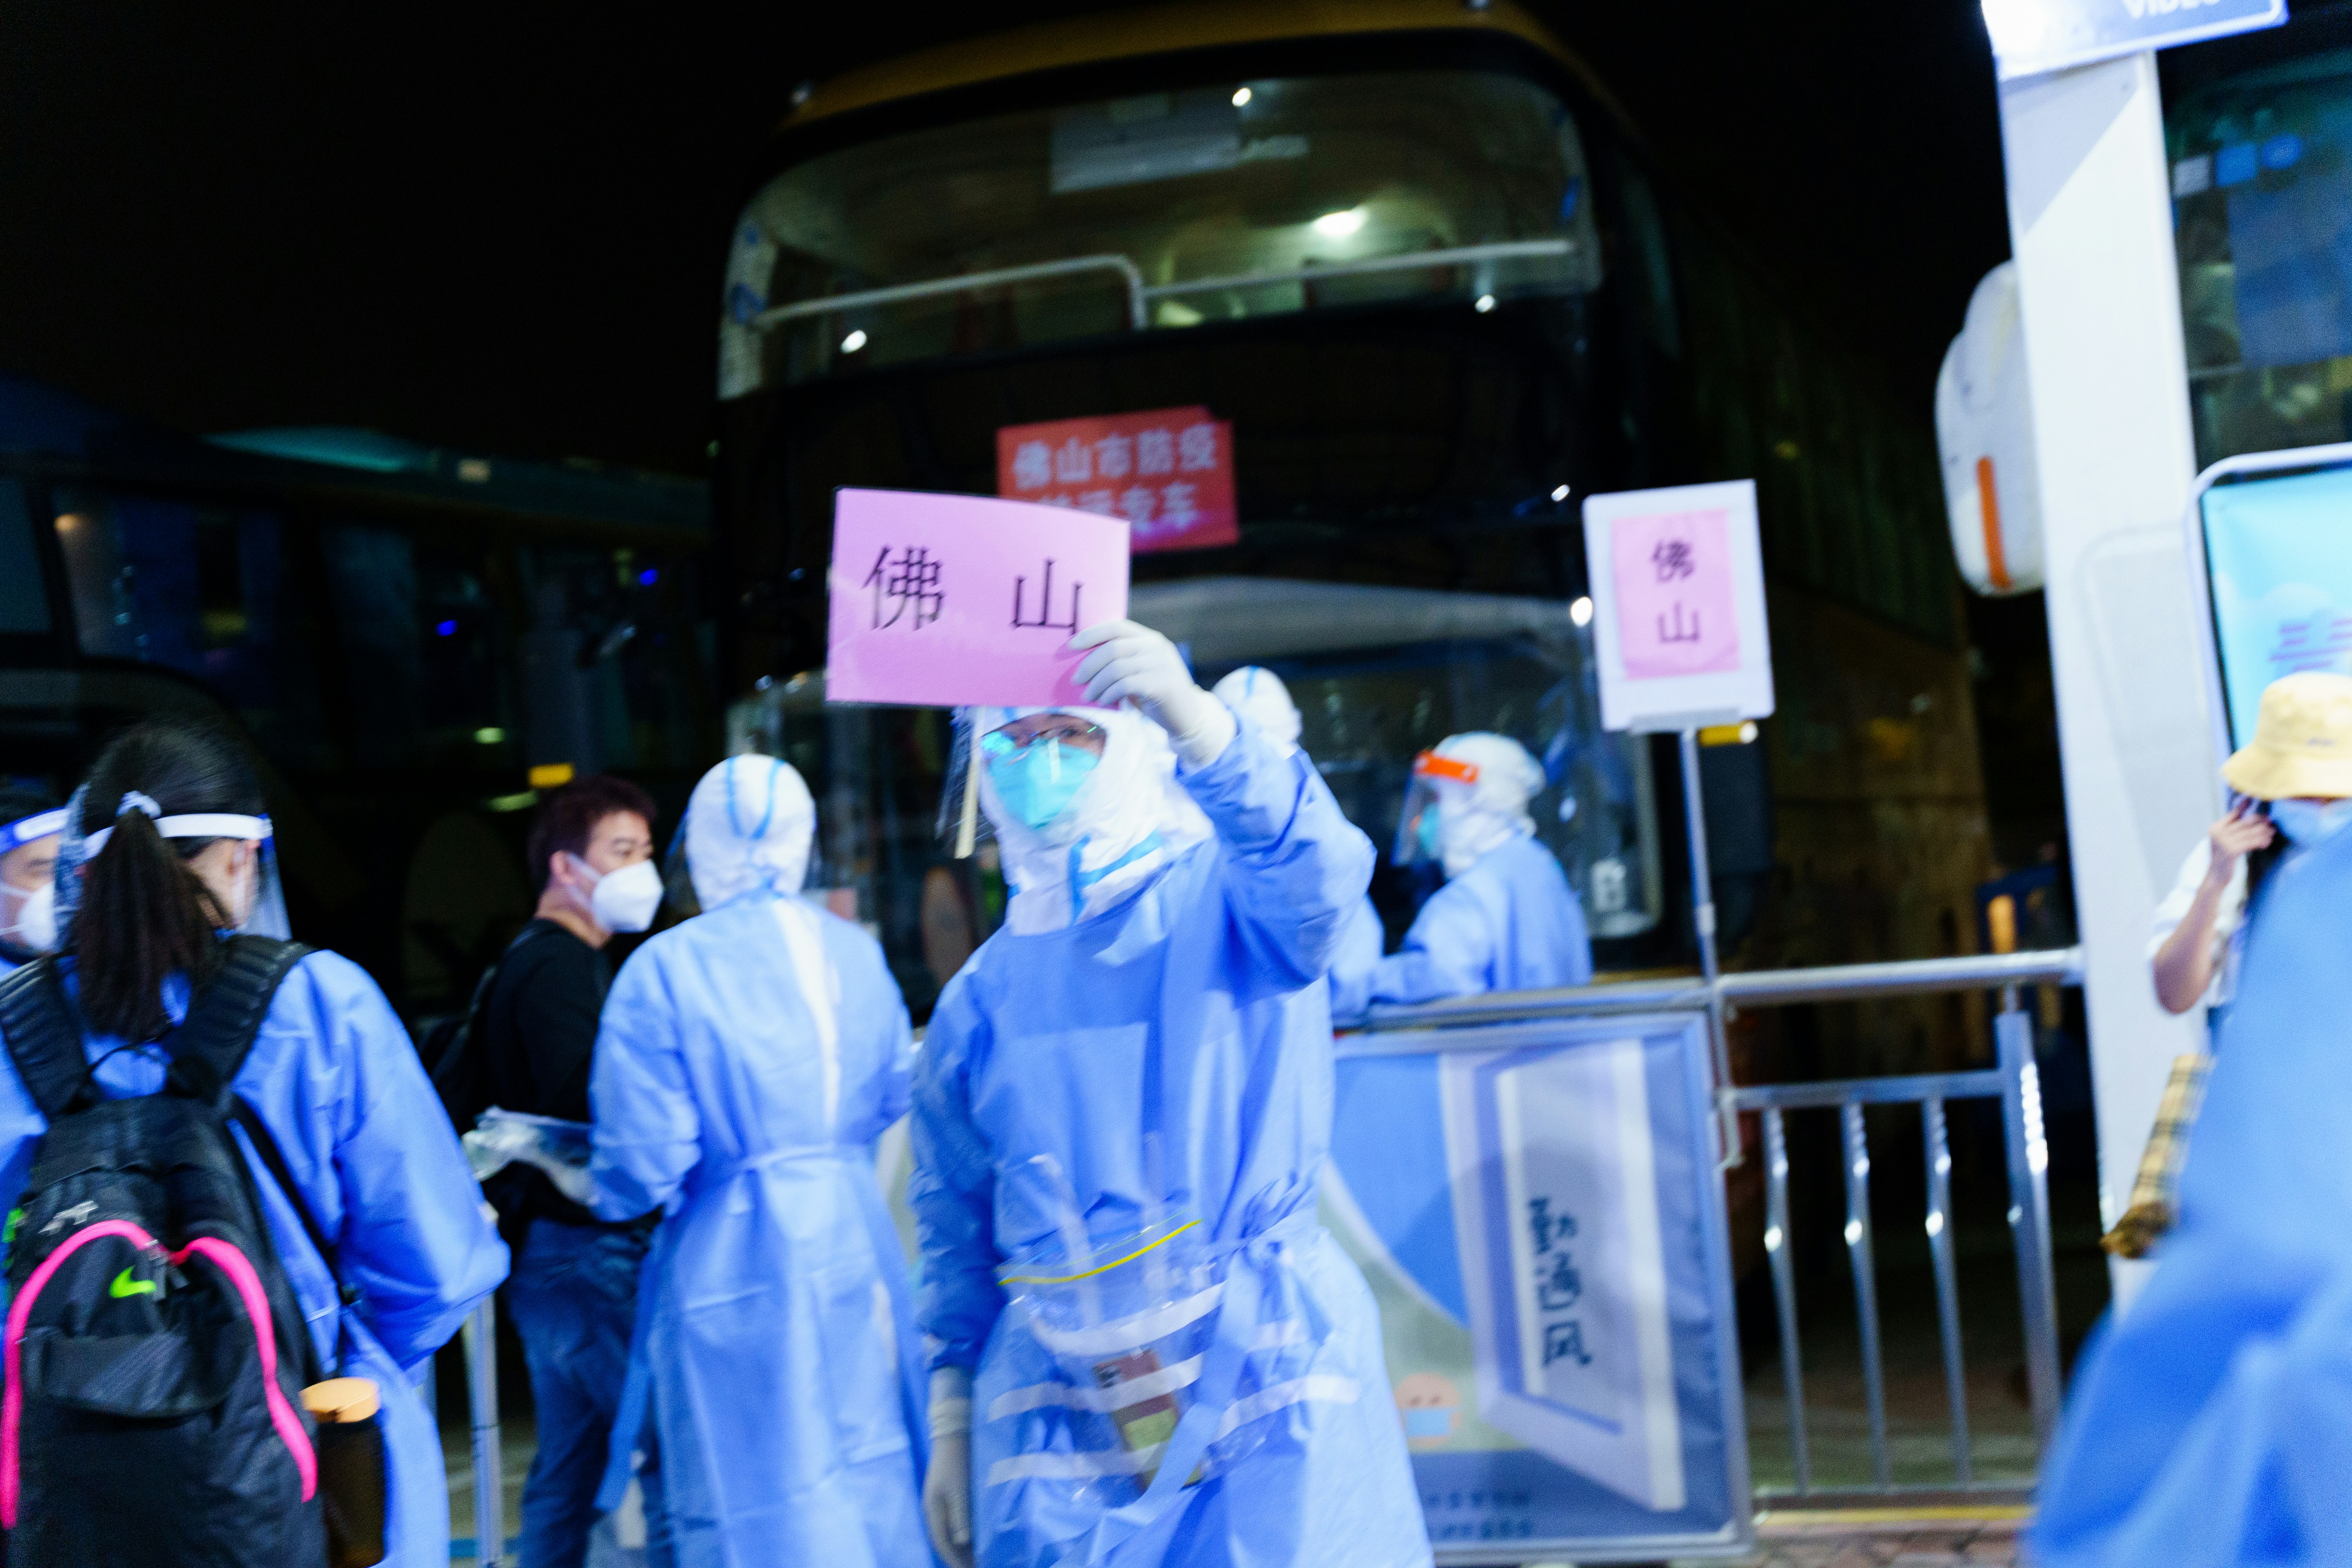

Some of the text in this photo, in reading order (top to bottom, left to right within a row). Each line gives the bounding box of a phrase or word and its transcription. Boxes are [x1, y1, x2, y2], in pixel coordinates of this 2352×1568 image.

[1012, 423, 1216, 491] 佛山市防疫
[862, 543, 1083, 636] 佛山
[1651, 539, 1700, 644] 佛山
